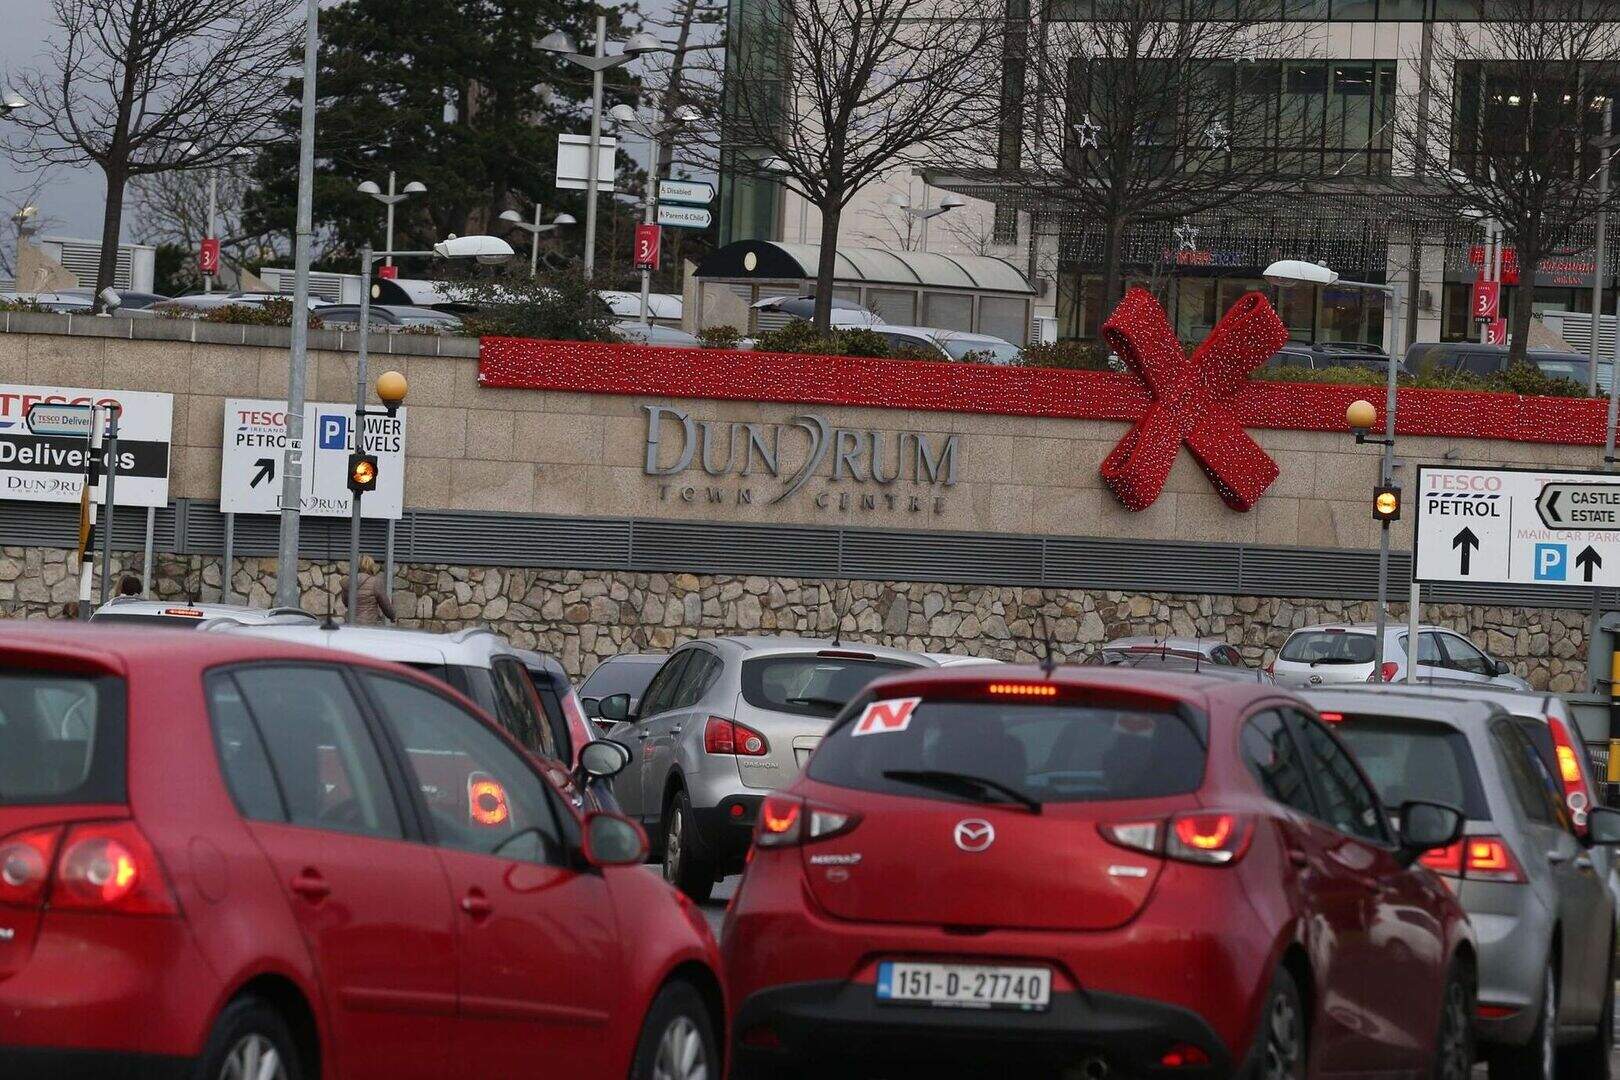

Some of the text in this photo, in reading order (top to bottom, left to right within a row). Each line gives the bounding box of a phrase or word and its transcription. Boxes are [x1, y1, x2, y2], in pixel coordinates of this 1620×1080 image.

[667, 187, 691, 195] Disabled
[666, 211, 683, 220] Parent
[640, 240, 648, 258] 3
[204, 251, 210, 266] 3
[1479, 295, 1487, 312] 3
[1488, 330, 1494, 344] 3
[238, 411, 288, 426] TESC
[348, 418, 400, 434] LWER
[326, 420, 340, 444] P
[236, 434, 286, 448] PETRO
[348, 435, 400, 452] LVELS
[1427, 474, 1502, 492] TESCO
[658, 486, 948, 514] TOWN CENTRE
[1571, 492, 1620, 504] CASTLE
[1428, 499, 1500, 518] PETROL
[1572, 510, 1615, 522] ESTATE
[1517, 530, 1620, 542] MAIN CAR PARK
[1540, 548, 1560, 576] P
[861, 702, 913, 730] N
[900, 971, 1041, 1000] 151-D-27740
